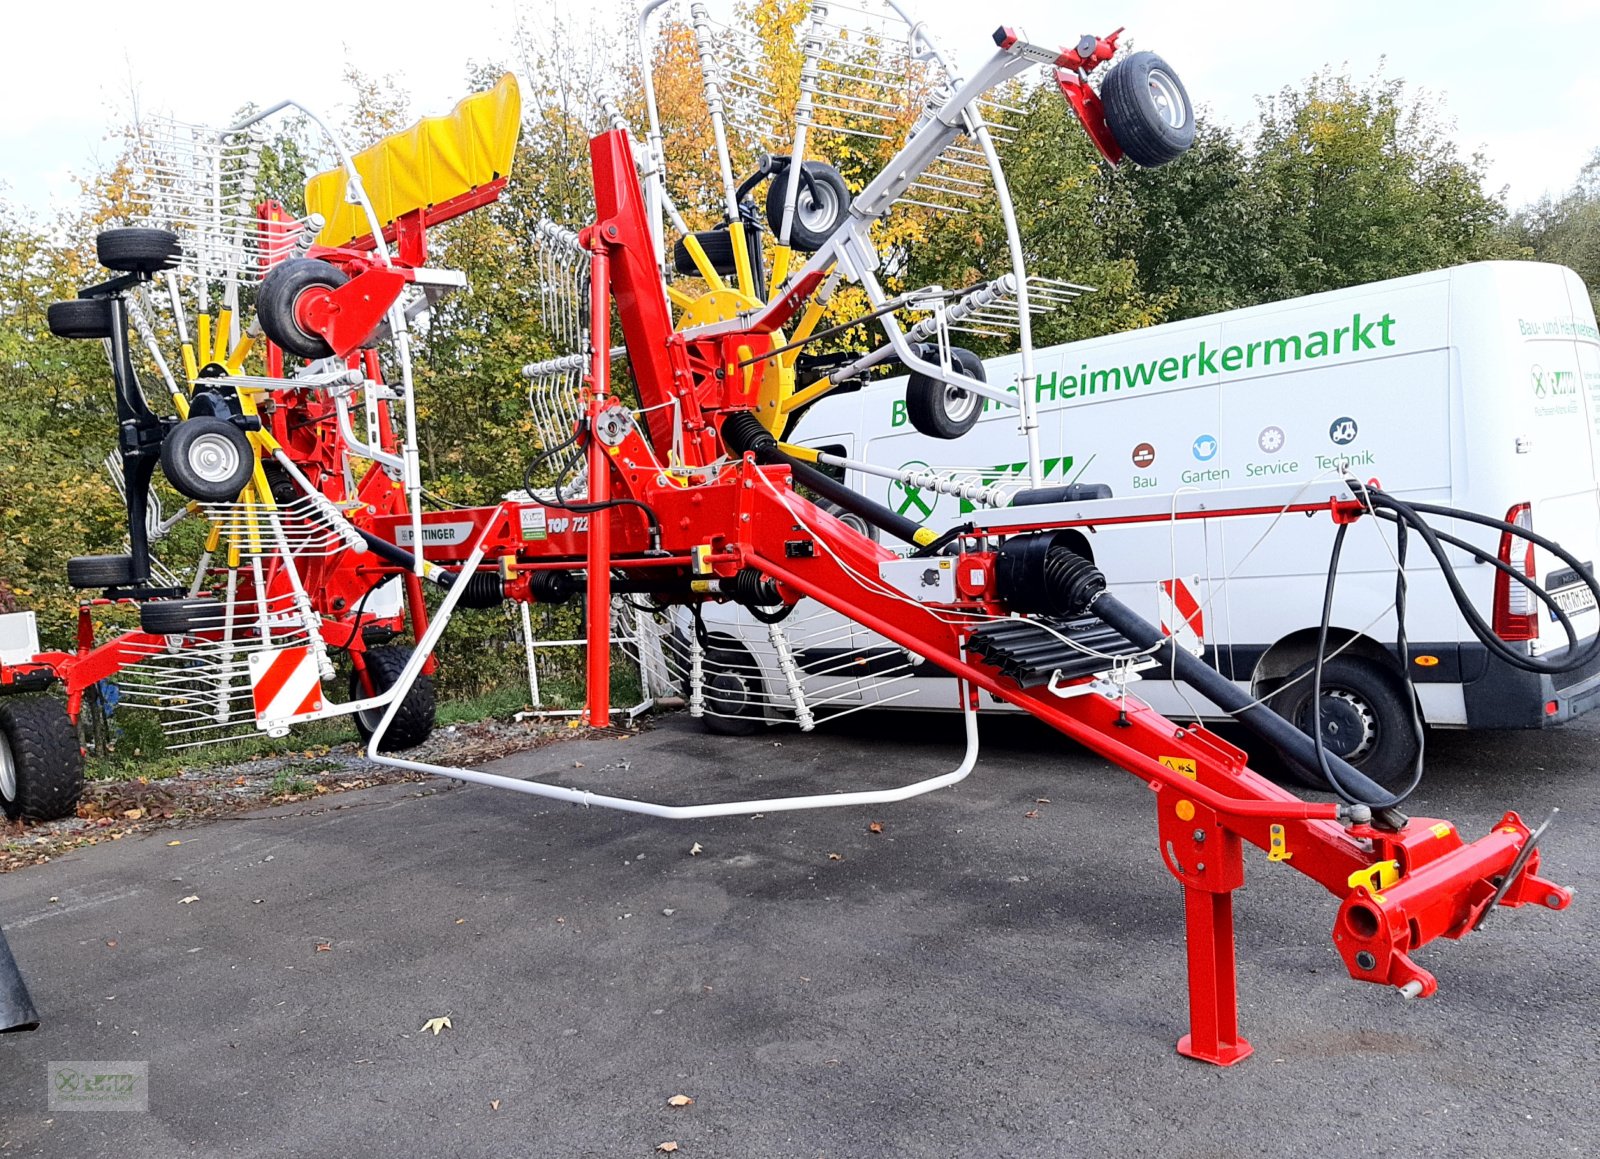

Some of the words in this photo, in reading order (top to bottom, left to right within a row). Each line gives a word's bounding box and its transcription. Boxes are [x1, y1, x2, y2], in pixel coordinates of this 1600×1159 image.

[1035, 313, 1395, 403] Heimwerkermarkt
[1315, 449, 1375, 470] Technik
[1181, 467, 1230, 484] Garten
[1246, 459, 1299, 478] Service
[1133, 475, 1158, 489] Bau
[547, 517, 569, 533] TOP
[408, 528, 455, 541] PTTINGER
